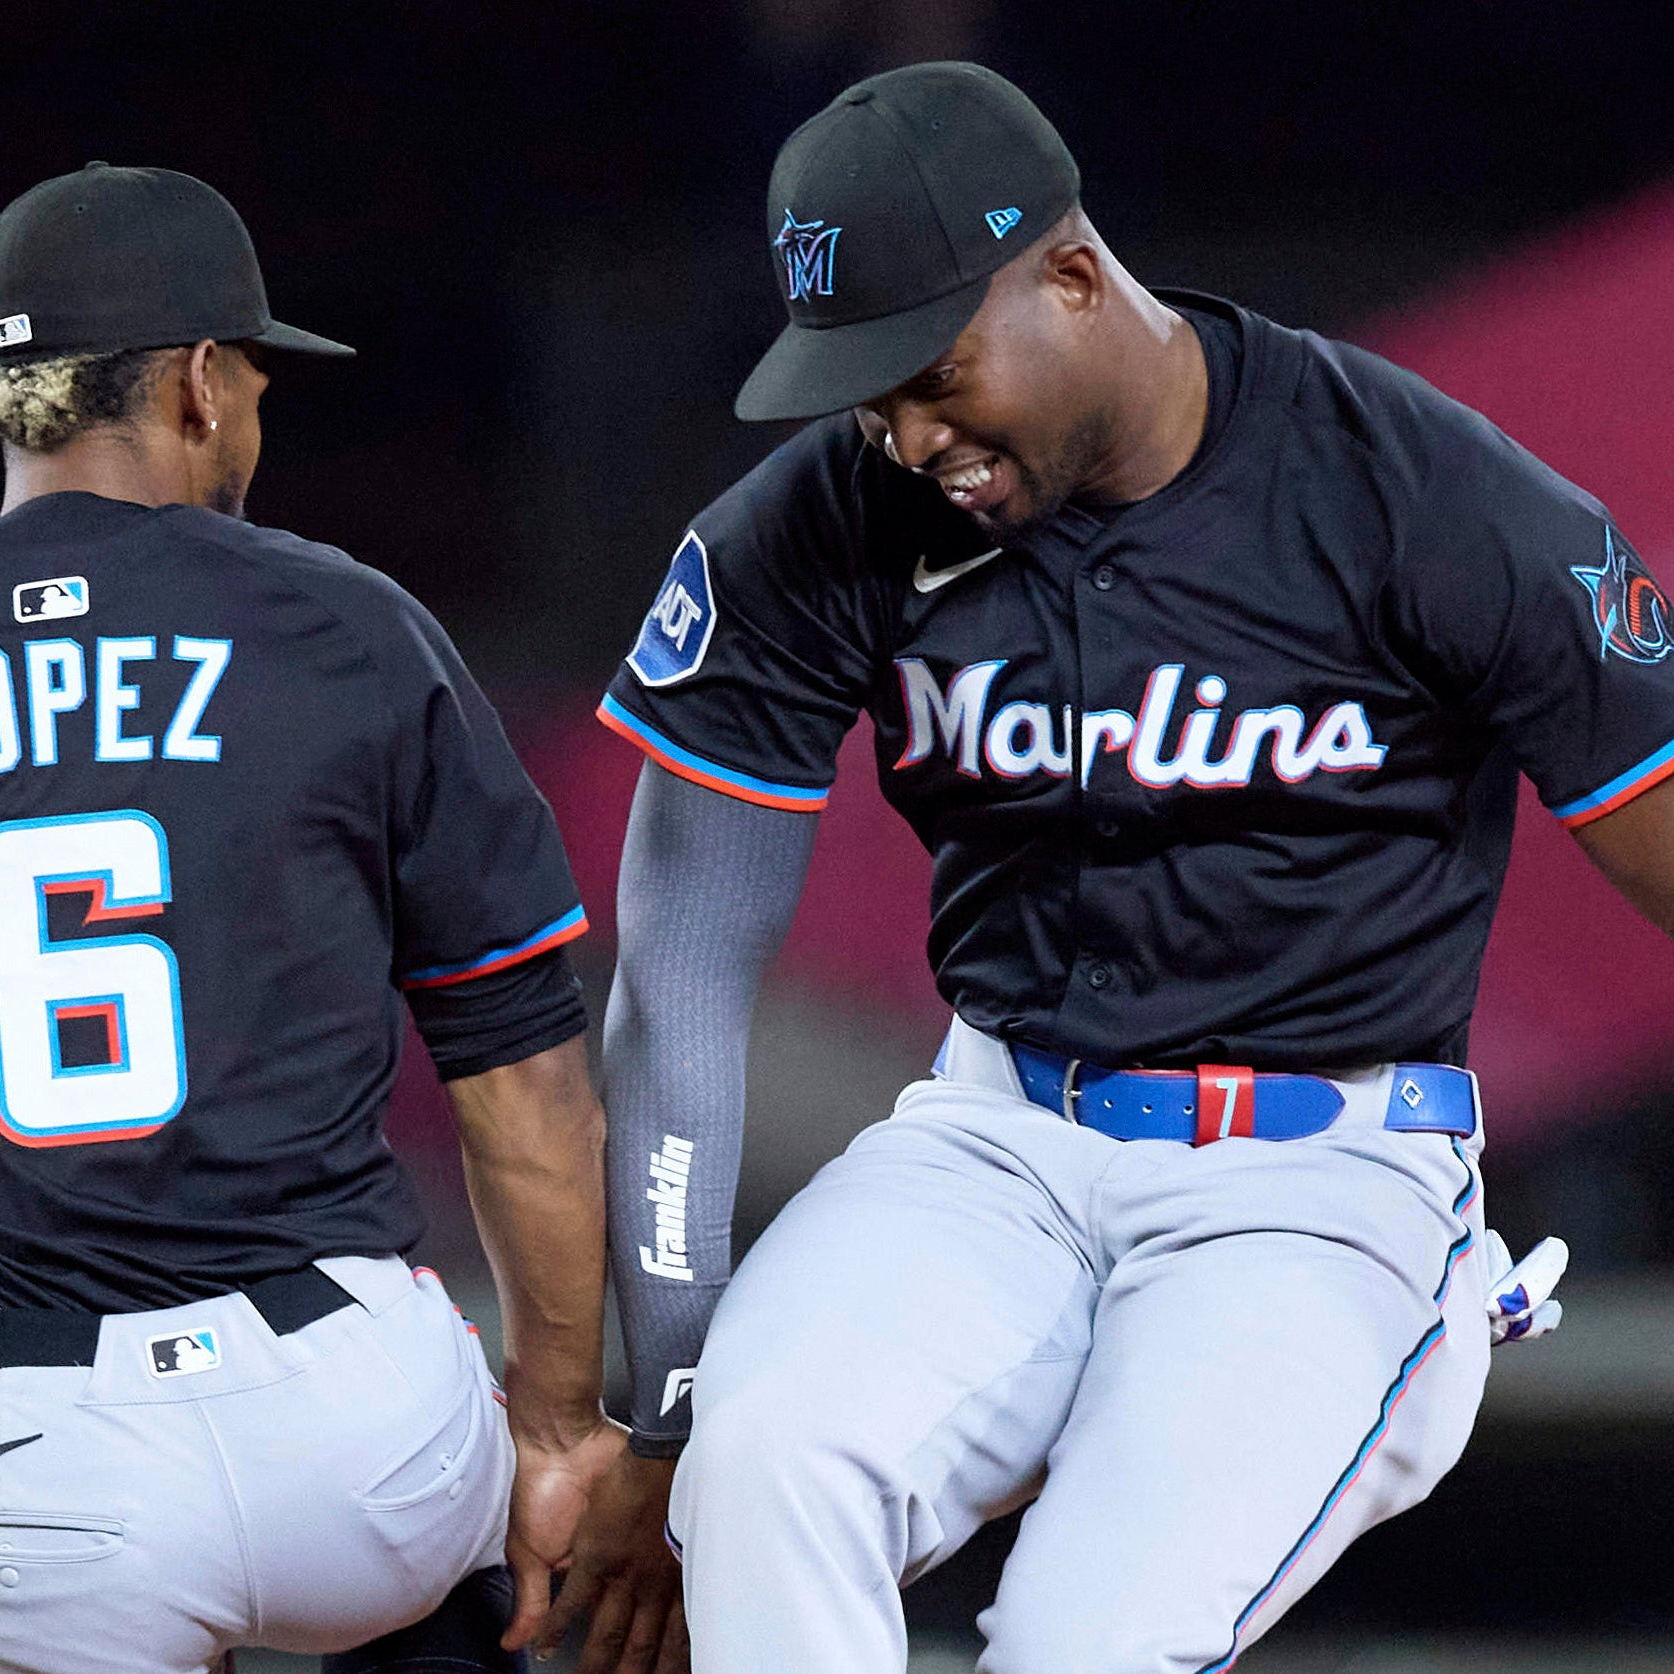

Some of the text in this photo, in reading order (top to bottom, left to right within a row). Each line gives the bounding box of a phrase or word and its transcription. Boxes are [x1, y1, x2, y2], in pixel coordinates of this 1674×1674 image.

[653, 580, 702, 652] ADT
[893, 658, 1389, 791] Marlins
[1215, 1077, 1238, 1138] 7
[639, 1134, 694, 1282] Franklin
